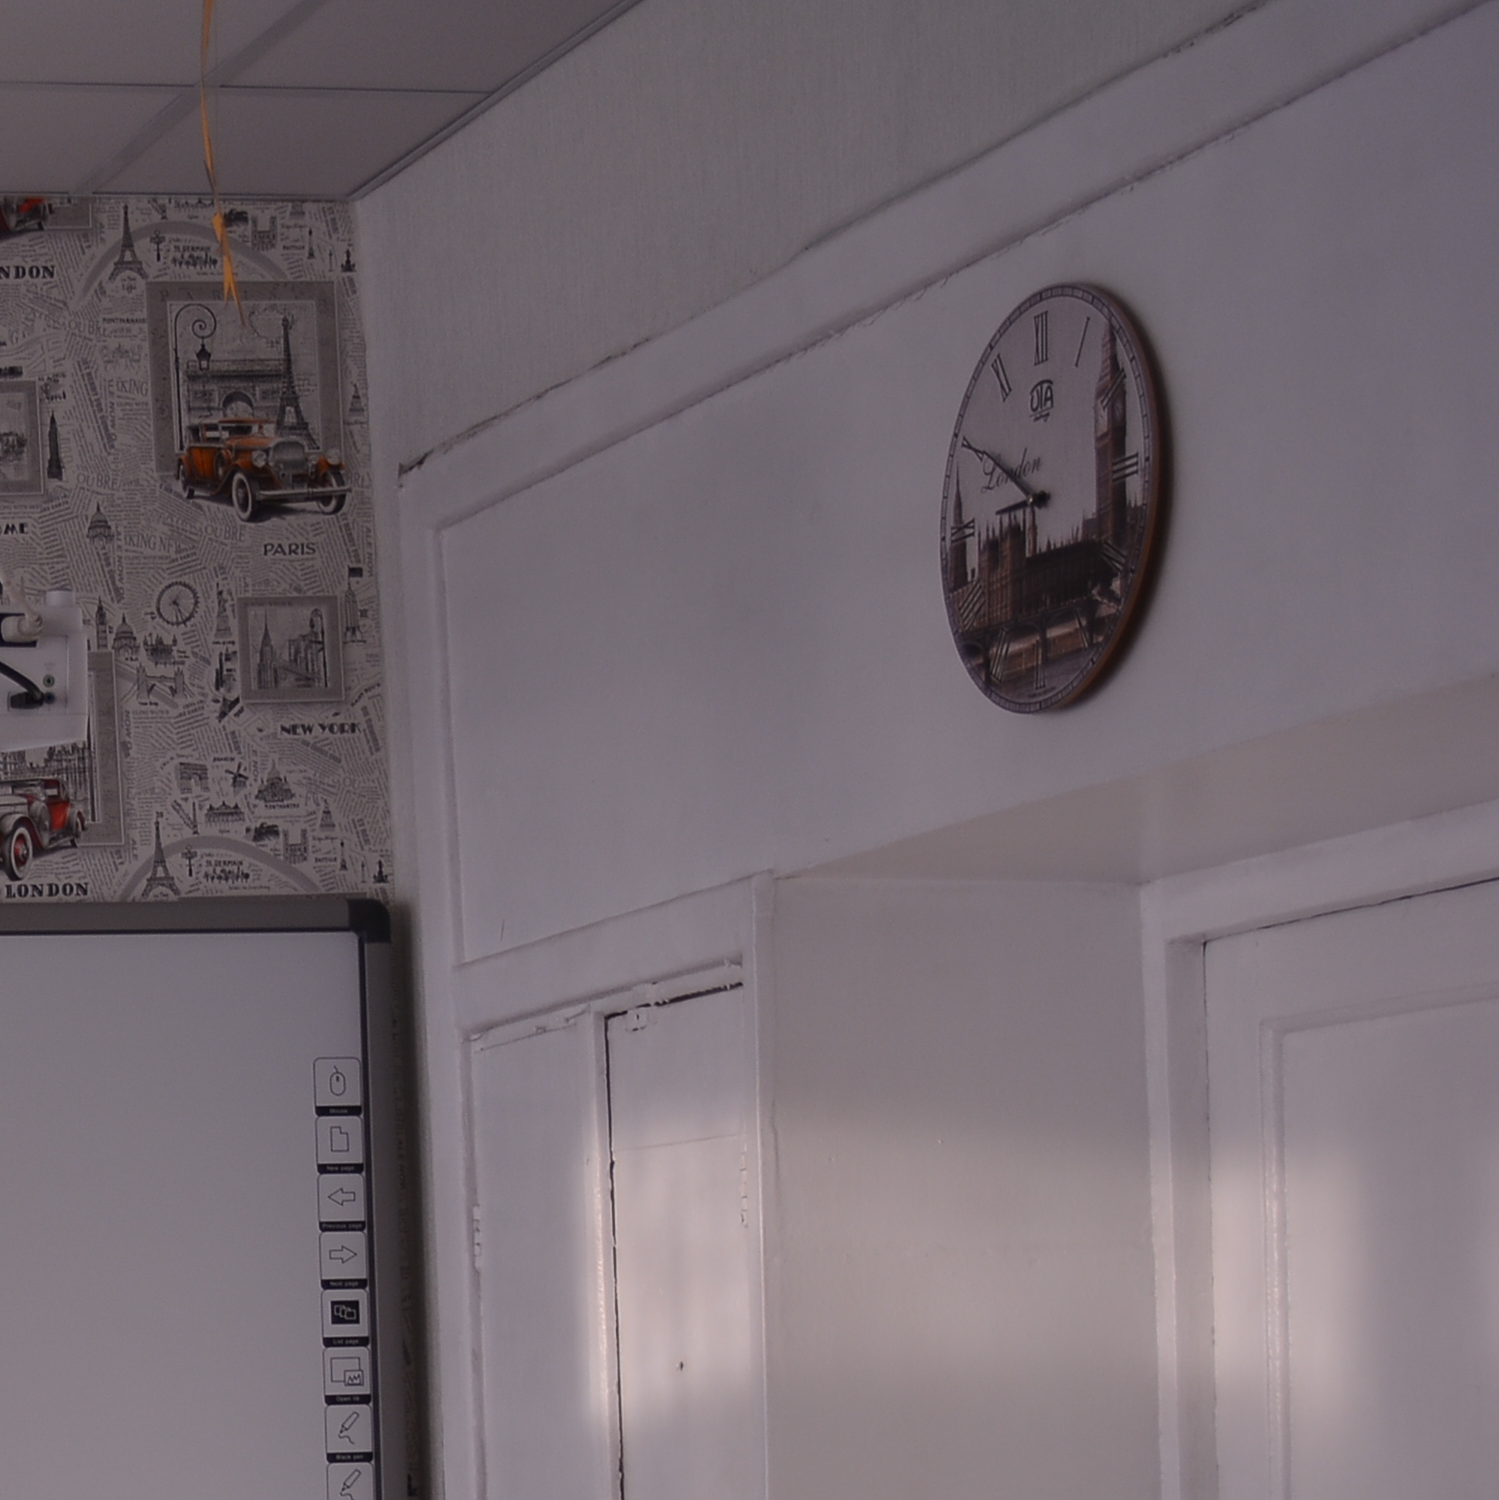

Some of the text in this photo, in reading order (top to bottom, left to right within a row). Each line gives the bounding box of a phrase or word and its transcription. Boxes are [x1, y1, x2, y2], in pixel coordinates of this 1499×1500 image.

[263, 541, 318, 557] PARIS
[280, 721, 361, 737] NEW YORK
[6, 882, 89, 899] LONDON
